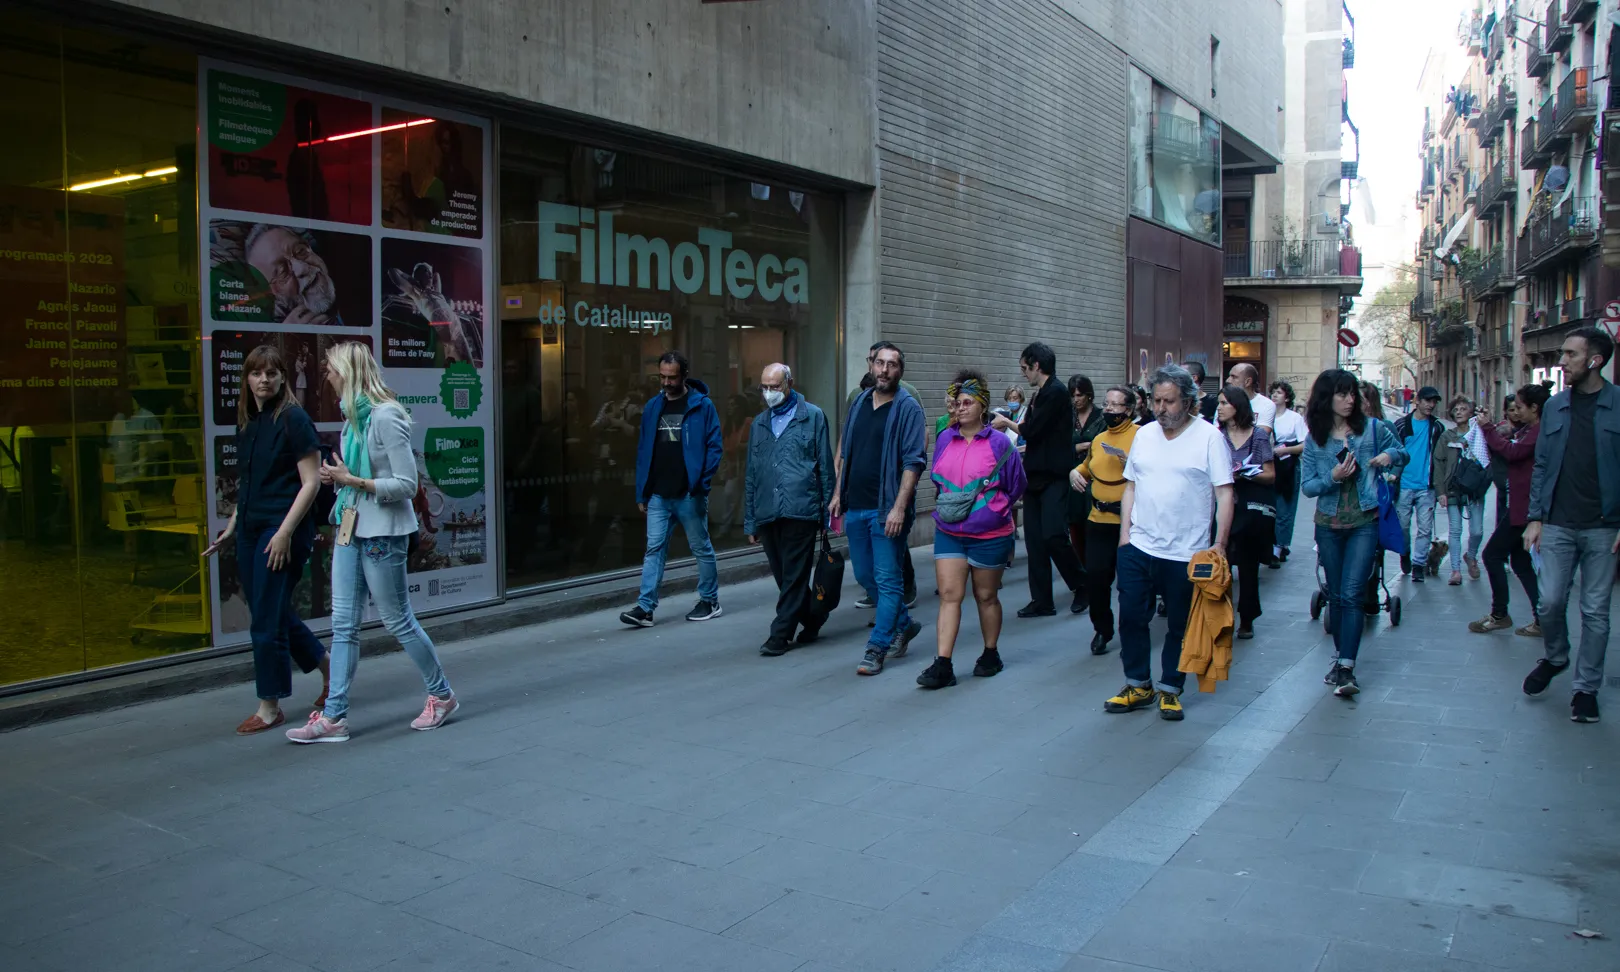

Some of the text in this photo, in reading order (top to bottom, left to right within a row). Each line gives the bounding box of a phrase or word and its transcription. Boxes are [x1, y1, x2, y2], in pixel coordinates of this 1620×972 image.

[218, 82, 260, 98] Moments
[218, 118, 273, 136] Filmoteques
[218, 132, 257, 145] amigues
[452, 190, 477, 202] Jeremy
[448, 199, 477, 212] Thomas,
[441, 210, 477, 221] emperador
[430, 217, 477, 231] de productors
[79, 252, 114, 265] 2022
[538, 200, 810, 304] FilmoTeca
[69, 282, 116, 295] Nazario
[219, 278, 244, 289] Carta
[219, 291, 249, 301] blanca
[83, 301, 117, 314] Jaoui
[219, 303, 262, 313] a Nazario
[538, 299, 672, 336] de Catalunya
[75, 319, 117, 332] Piavoli
[25, 337, 118, 350] Jaime Camino
[388, 338, 426, 347] Els millors
[220, 350, 243, 358] Alain
[388, 349, 406, 357] films
[50, 357, 118, 371] Perejaume
[26, 376, 55, 388] dins
[58, 375, 70, 387] el
[74, 376, 119, 387] cinema
[220, 374, 229, 383] el
[221, 386, 229, 395] la
[226, 399, 236, 407] el
[461, 455, 479, 464] Cicle
[448, 466, 479, 475] Criatures
